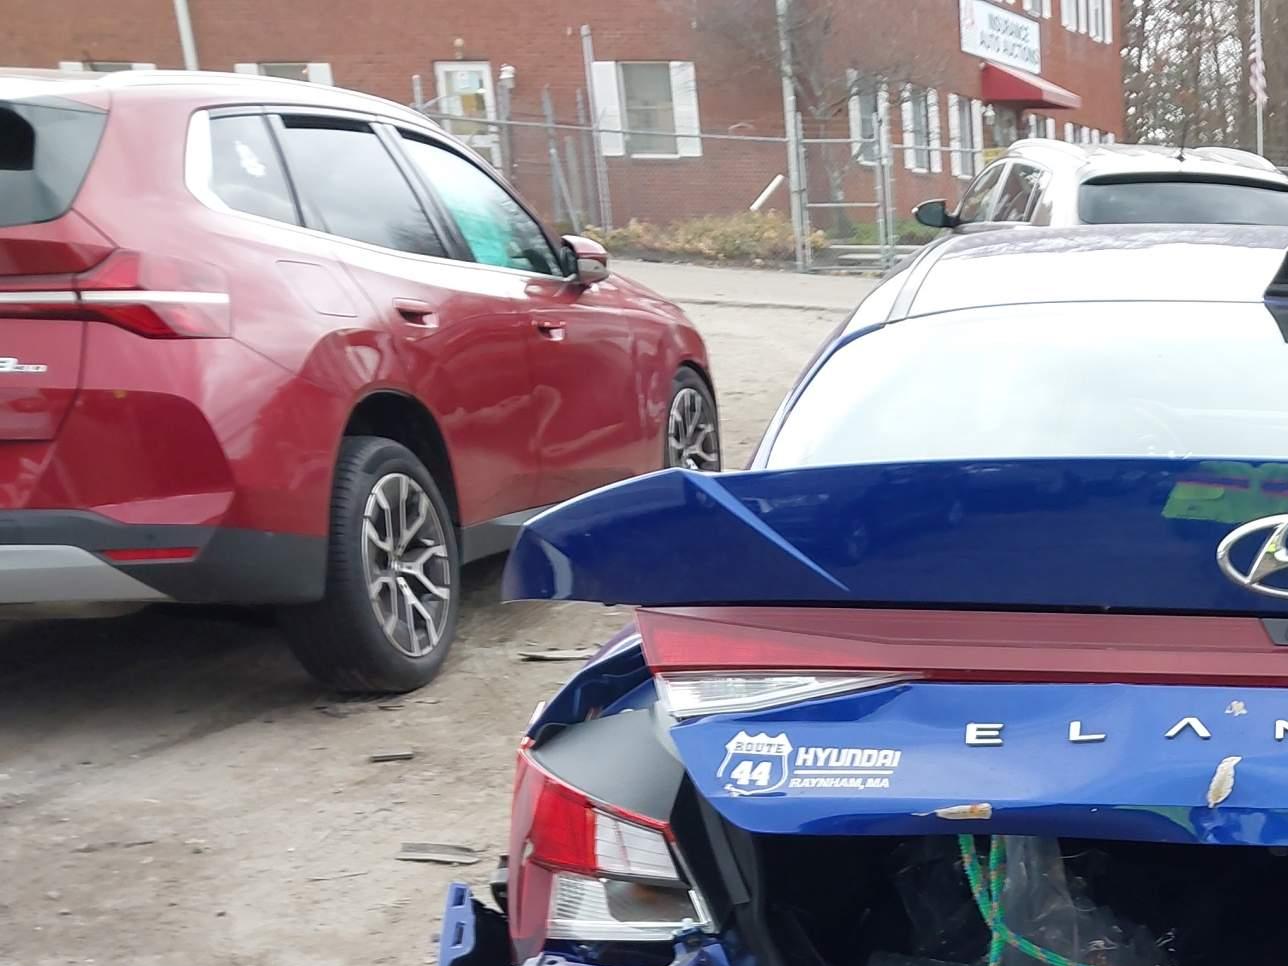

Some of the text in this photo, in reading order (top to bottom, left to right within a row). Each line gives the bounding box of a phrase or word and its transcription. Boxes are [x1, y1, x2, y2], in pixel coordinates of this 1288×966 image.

[735, 741, 785, 755] ROUTE
[795, 746, 901, 767] HYUNDAI
[730, 760, 772, 786] 44
